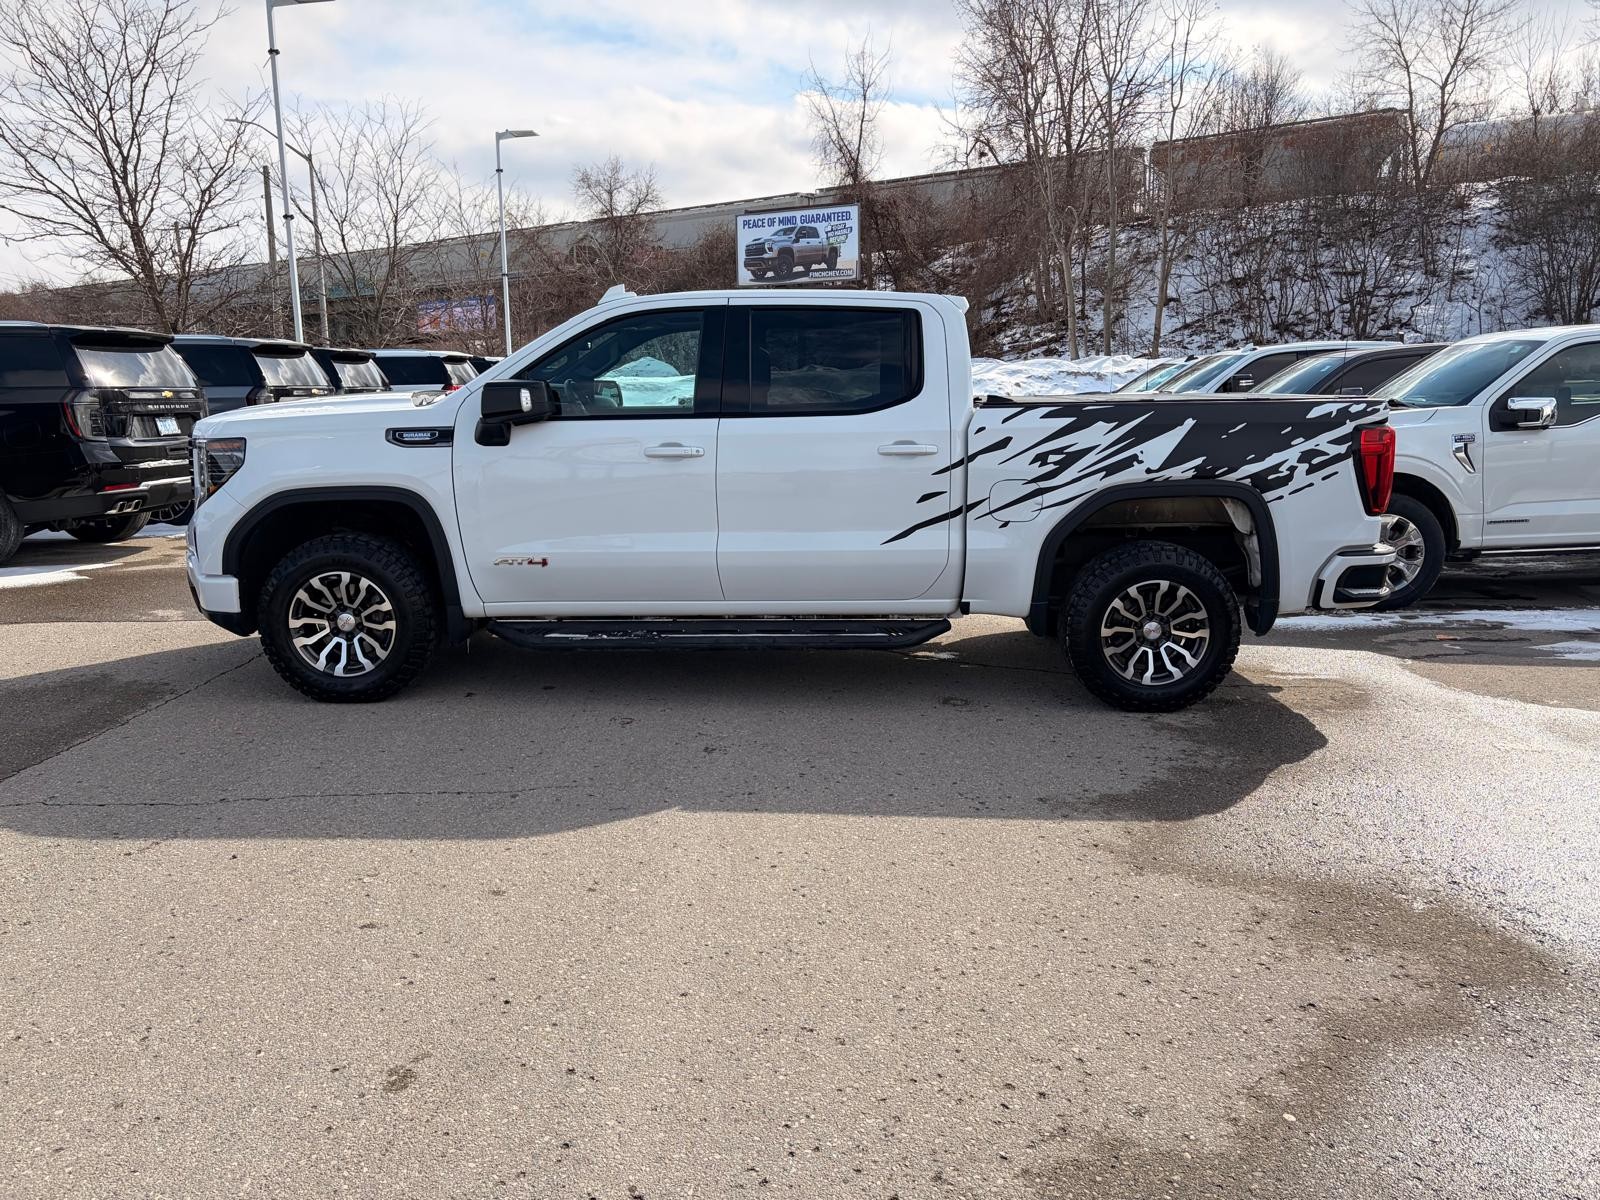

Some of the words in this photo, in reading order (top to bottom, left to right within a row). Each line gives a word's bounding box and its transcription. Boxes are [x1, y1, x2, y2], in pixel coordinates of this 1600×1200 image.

[743, 217, 766, 229] PEACE
[767, 217, 777, 227] OF
[800, 211, 853, 224] GUARANTEED.
[810, 269, 853, 278] FINCHCHEV.COM
[494, 556, 549, 567] AT4
